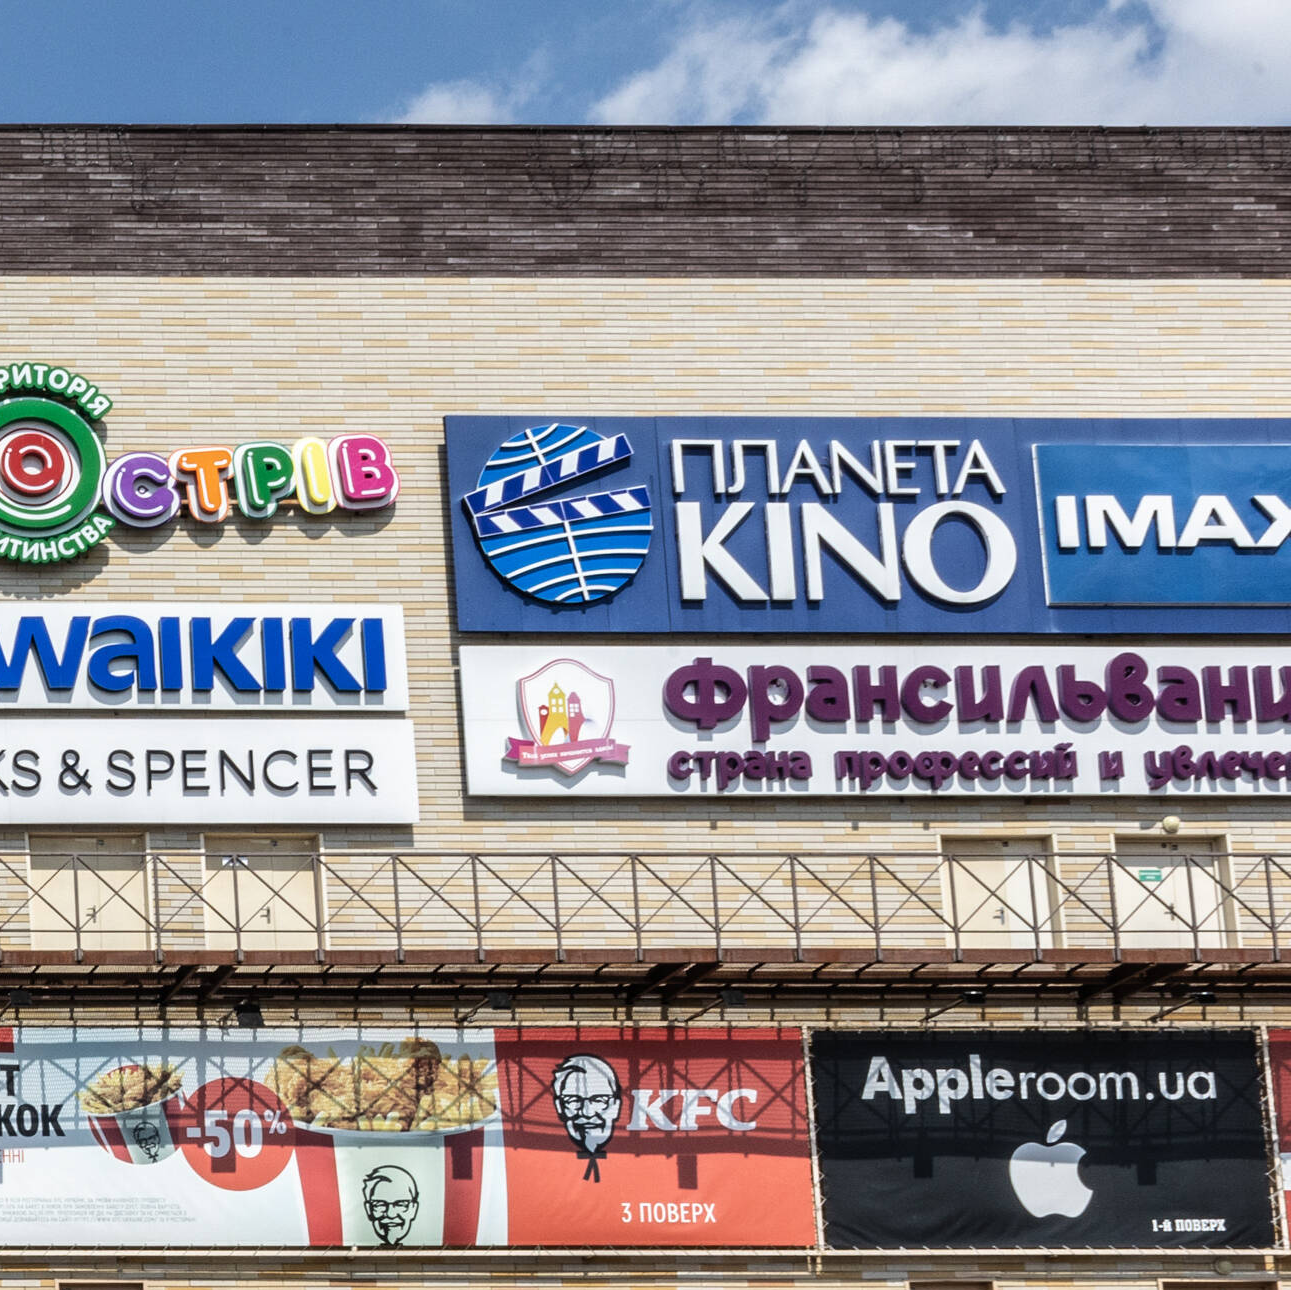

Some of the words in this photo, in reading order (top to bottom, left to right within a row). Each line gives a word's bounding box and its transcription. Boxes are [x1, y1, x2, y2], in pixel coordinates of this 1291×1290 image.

[1055, 494, 1291, 548] IMAX
[675, 501, 1018, 604] KINO
[57, 750, 91, 792] &
[105, 748, 377, 793] SPENCER
[668, 749, 813, 791] страна
[835, 741, 1078, 790] профессий
[1098, 750, 1125, 779] и
[1142, 744, 1291, 790] увлече
[862, 1054, 1216, 1114] Appleroom.ua
[186, 1109, 287, 1159] -50%
[627, 1089, 757, 1131] KFC
[621, 1203, 632, 1224] 3
[640, 1203, 716, 1224] ПОВЕРХ
[1175, 1219, 1226, 1233] ПОВЕРХ
